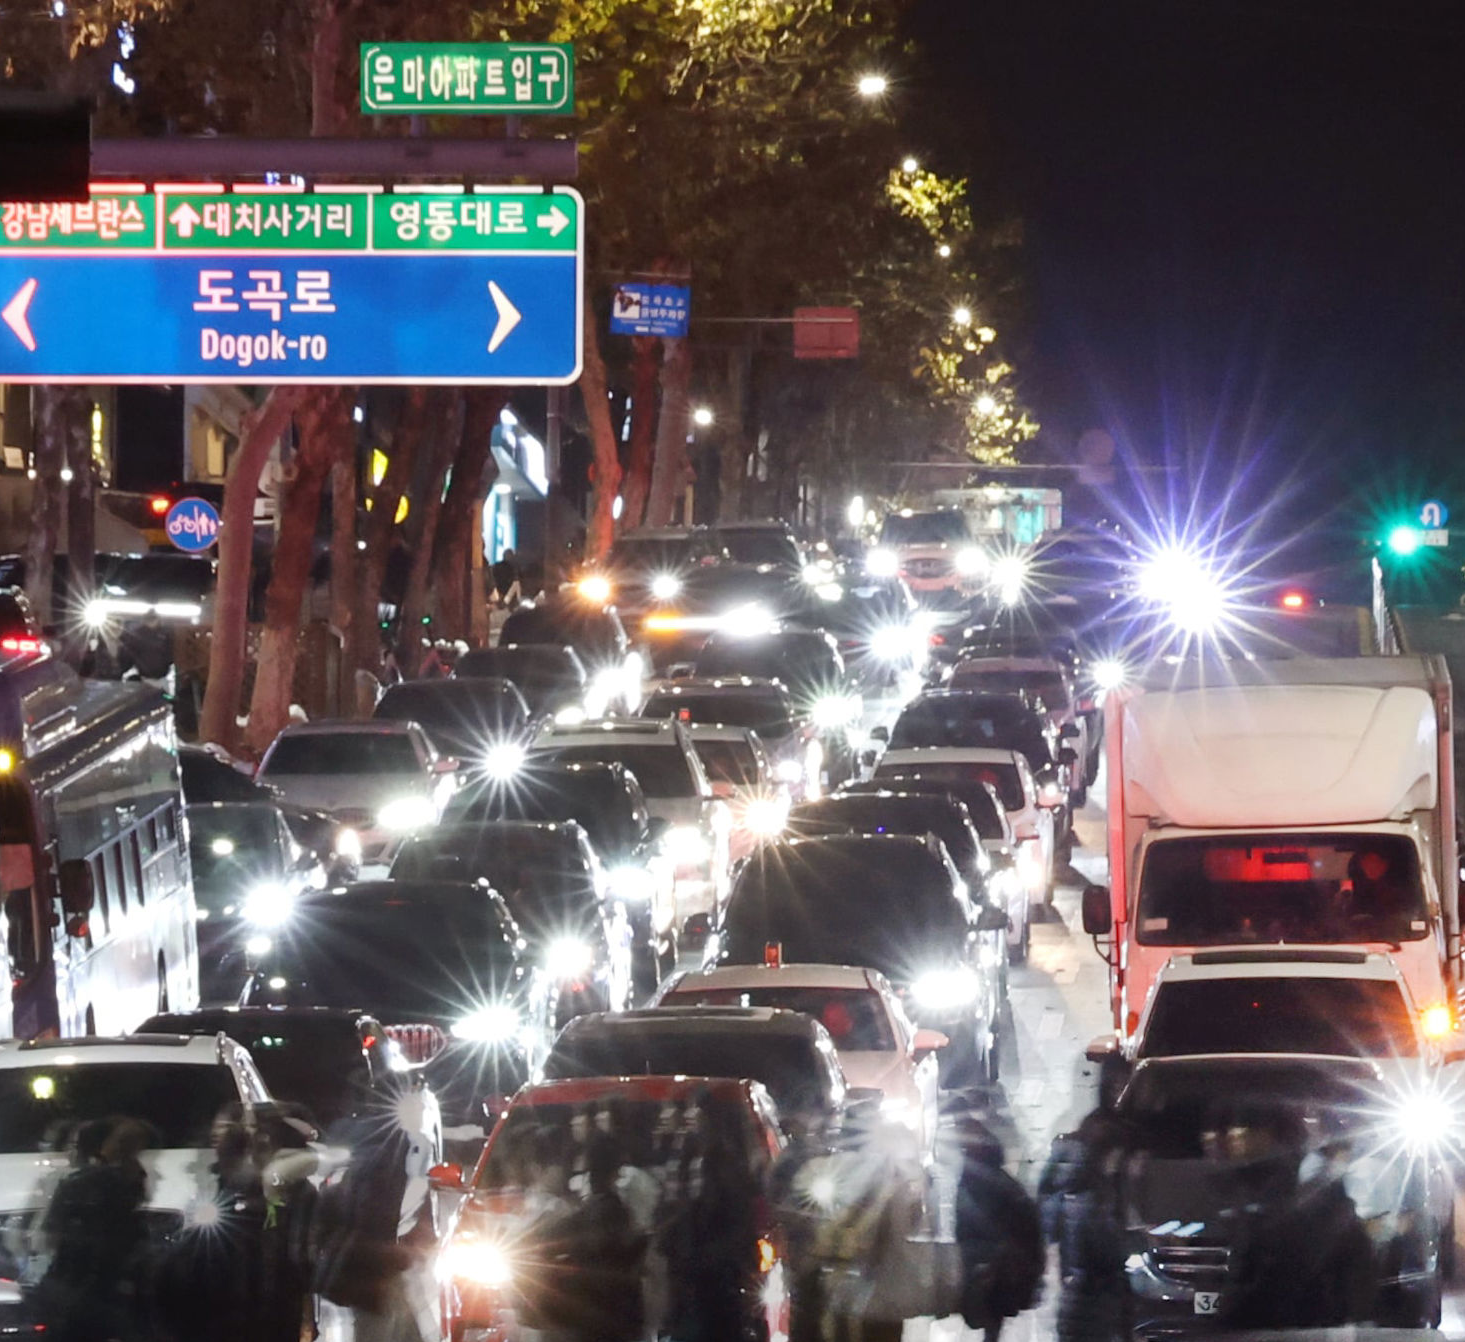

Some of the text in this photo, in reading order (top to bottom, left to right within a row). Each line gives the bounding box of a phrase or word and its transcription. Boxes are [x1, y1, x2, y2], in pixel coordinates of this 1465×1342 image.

[372, 55, 561, 101] 은마아파트입구
[1, 200, 146, 241] 강남세브란스
[203, 202, 353, 238] 대치사거리
[389, 201, 528, 241] 영동대로
[192, 270, 337, 322] 도곡로
[200, 328, 328, 367] Dogok-ro
